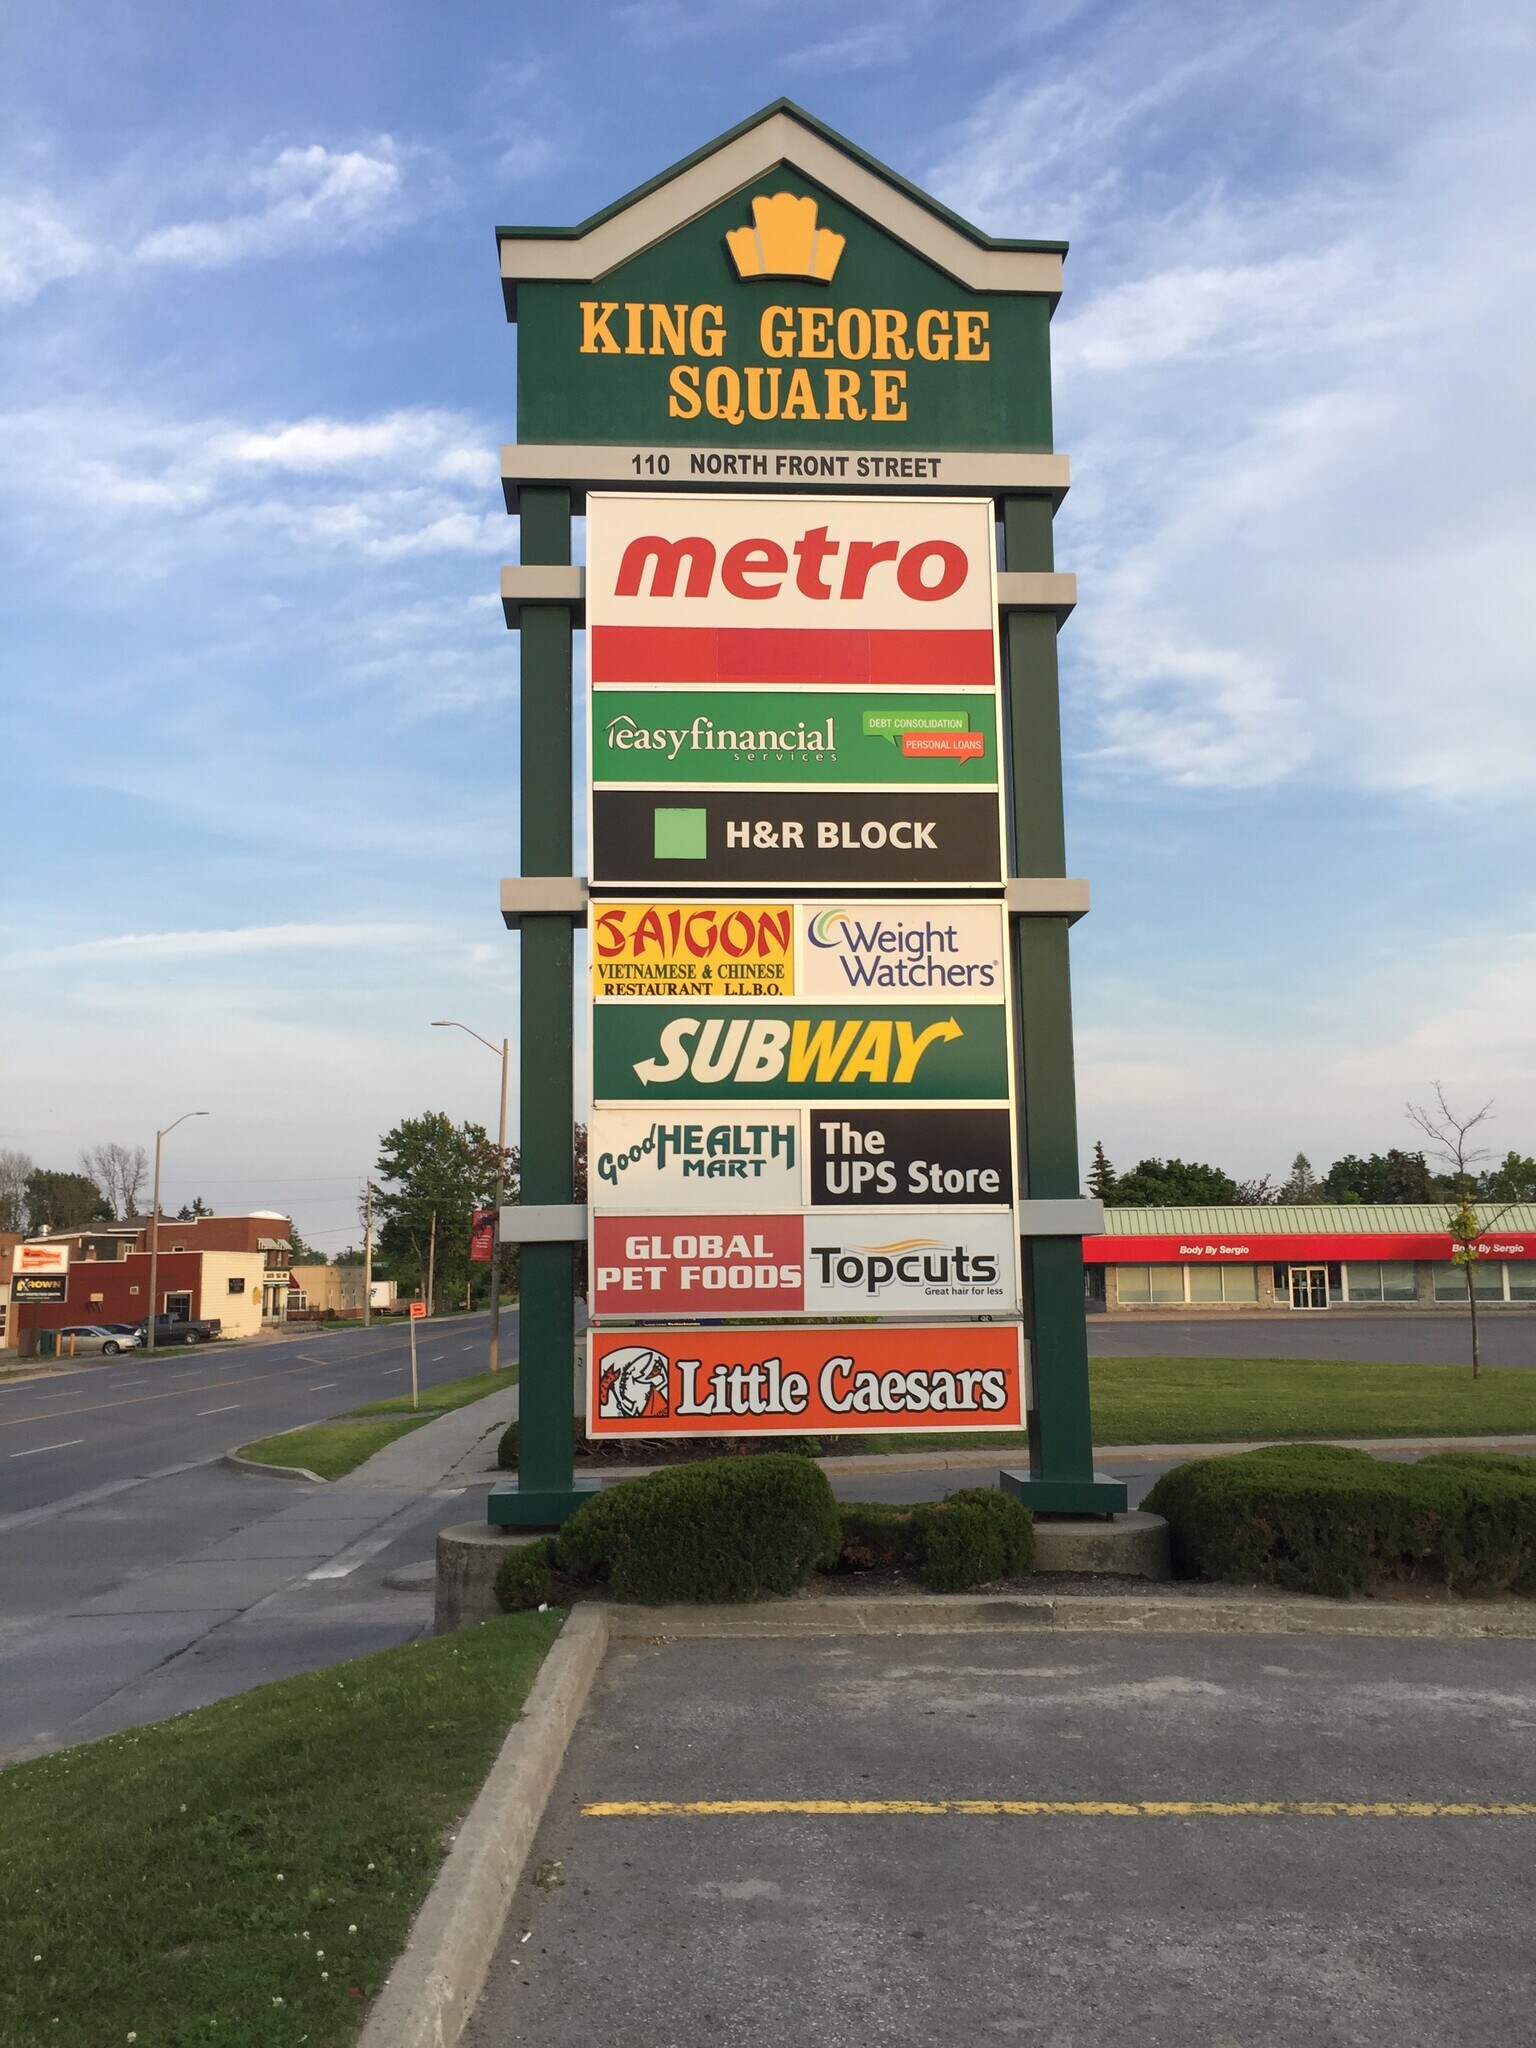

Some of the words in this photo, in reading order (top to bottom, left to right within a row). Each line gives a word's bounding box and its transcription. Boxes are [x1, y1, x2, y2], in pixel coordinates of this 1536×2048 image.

[579, 301, 727, 358] KING
[759, 305, 991, 362] GEORGE
[668, 365, 909, 426] SQUARE
[631, 454, 670, 475] 110
[690, 454, 767, 475] NORTH
[775, 455, 849, 477] FRONT
[856, 456, 942, 478] STREET
[613, 525, 969, 602] metro
[603, 715, 837, 760] easyfinancial
[869, 718, 892, 728] DEBT
[894, 719, 963, 729] CONSOLIDATION
[733, 752, 838, 762] services
[906, 740, 951, 750] PERSONAL
[953, 740, 982, 750] LOANS
[726, 820, 805, 849] H&R
[817, 821, 938, 849] BLOCK
[595, 905, 791, 959] SAIGON
[839, 921, 959, 962] Weight
[597, 963, 696, 980] VIETNAMESE
[702, 964, 713, 979] &
[717, 964, 785, 980] CHINESE
[604, 983, 713, 996] RESTAURANT
[724, 983, 783, 996] L.L.B.O.
[633, 1016, 964, 1087] SUBWAY
[819, 1122, 886, 1155] The
[597, 1123, 657, 1186] Good
[657, 1125, 795, 1170] HEALTH
[683, 1159, 767, 1179] MART
[825, 1160, 897, 1195] UPS
[908, 1160, 1000, 1195] Store
[625, 1234, 774, 1260] GLOBAL
[1179, 1245, 1204, 1255] Body
[1205, 1245, 1218, 1255] By
[1219, 1245, 1250, 1255] Sergio
[1478, 1244, 1491, 1254] By
[1493, 1244, 1525, 1254] Sergio
[597, 1265, 667, 1291] PET
[680, 1264, 802, 1290] FOODS
[810, 1246, 997, 1293] Topcuts
[924, 1287, 949, 1295] Great
[951, 1287, 969, 1295] hair
[971, 1287, 984, 1295] for
[986, 1287, 1003, 1295] less
[675, 1357, 810, 1416] Little
